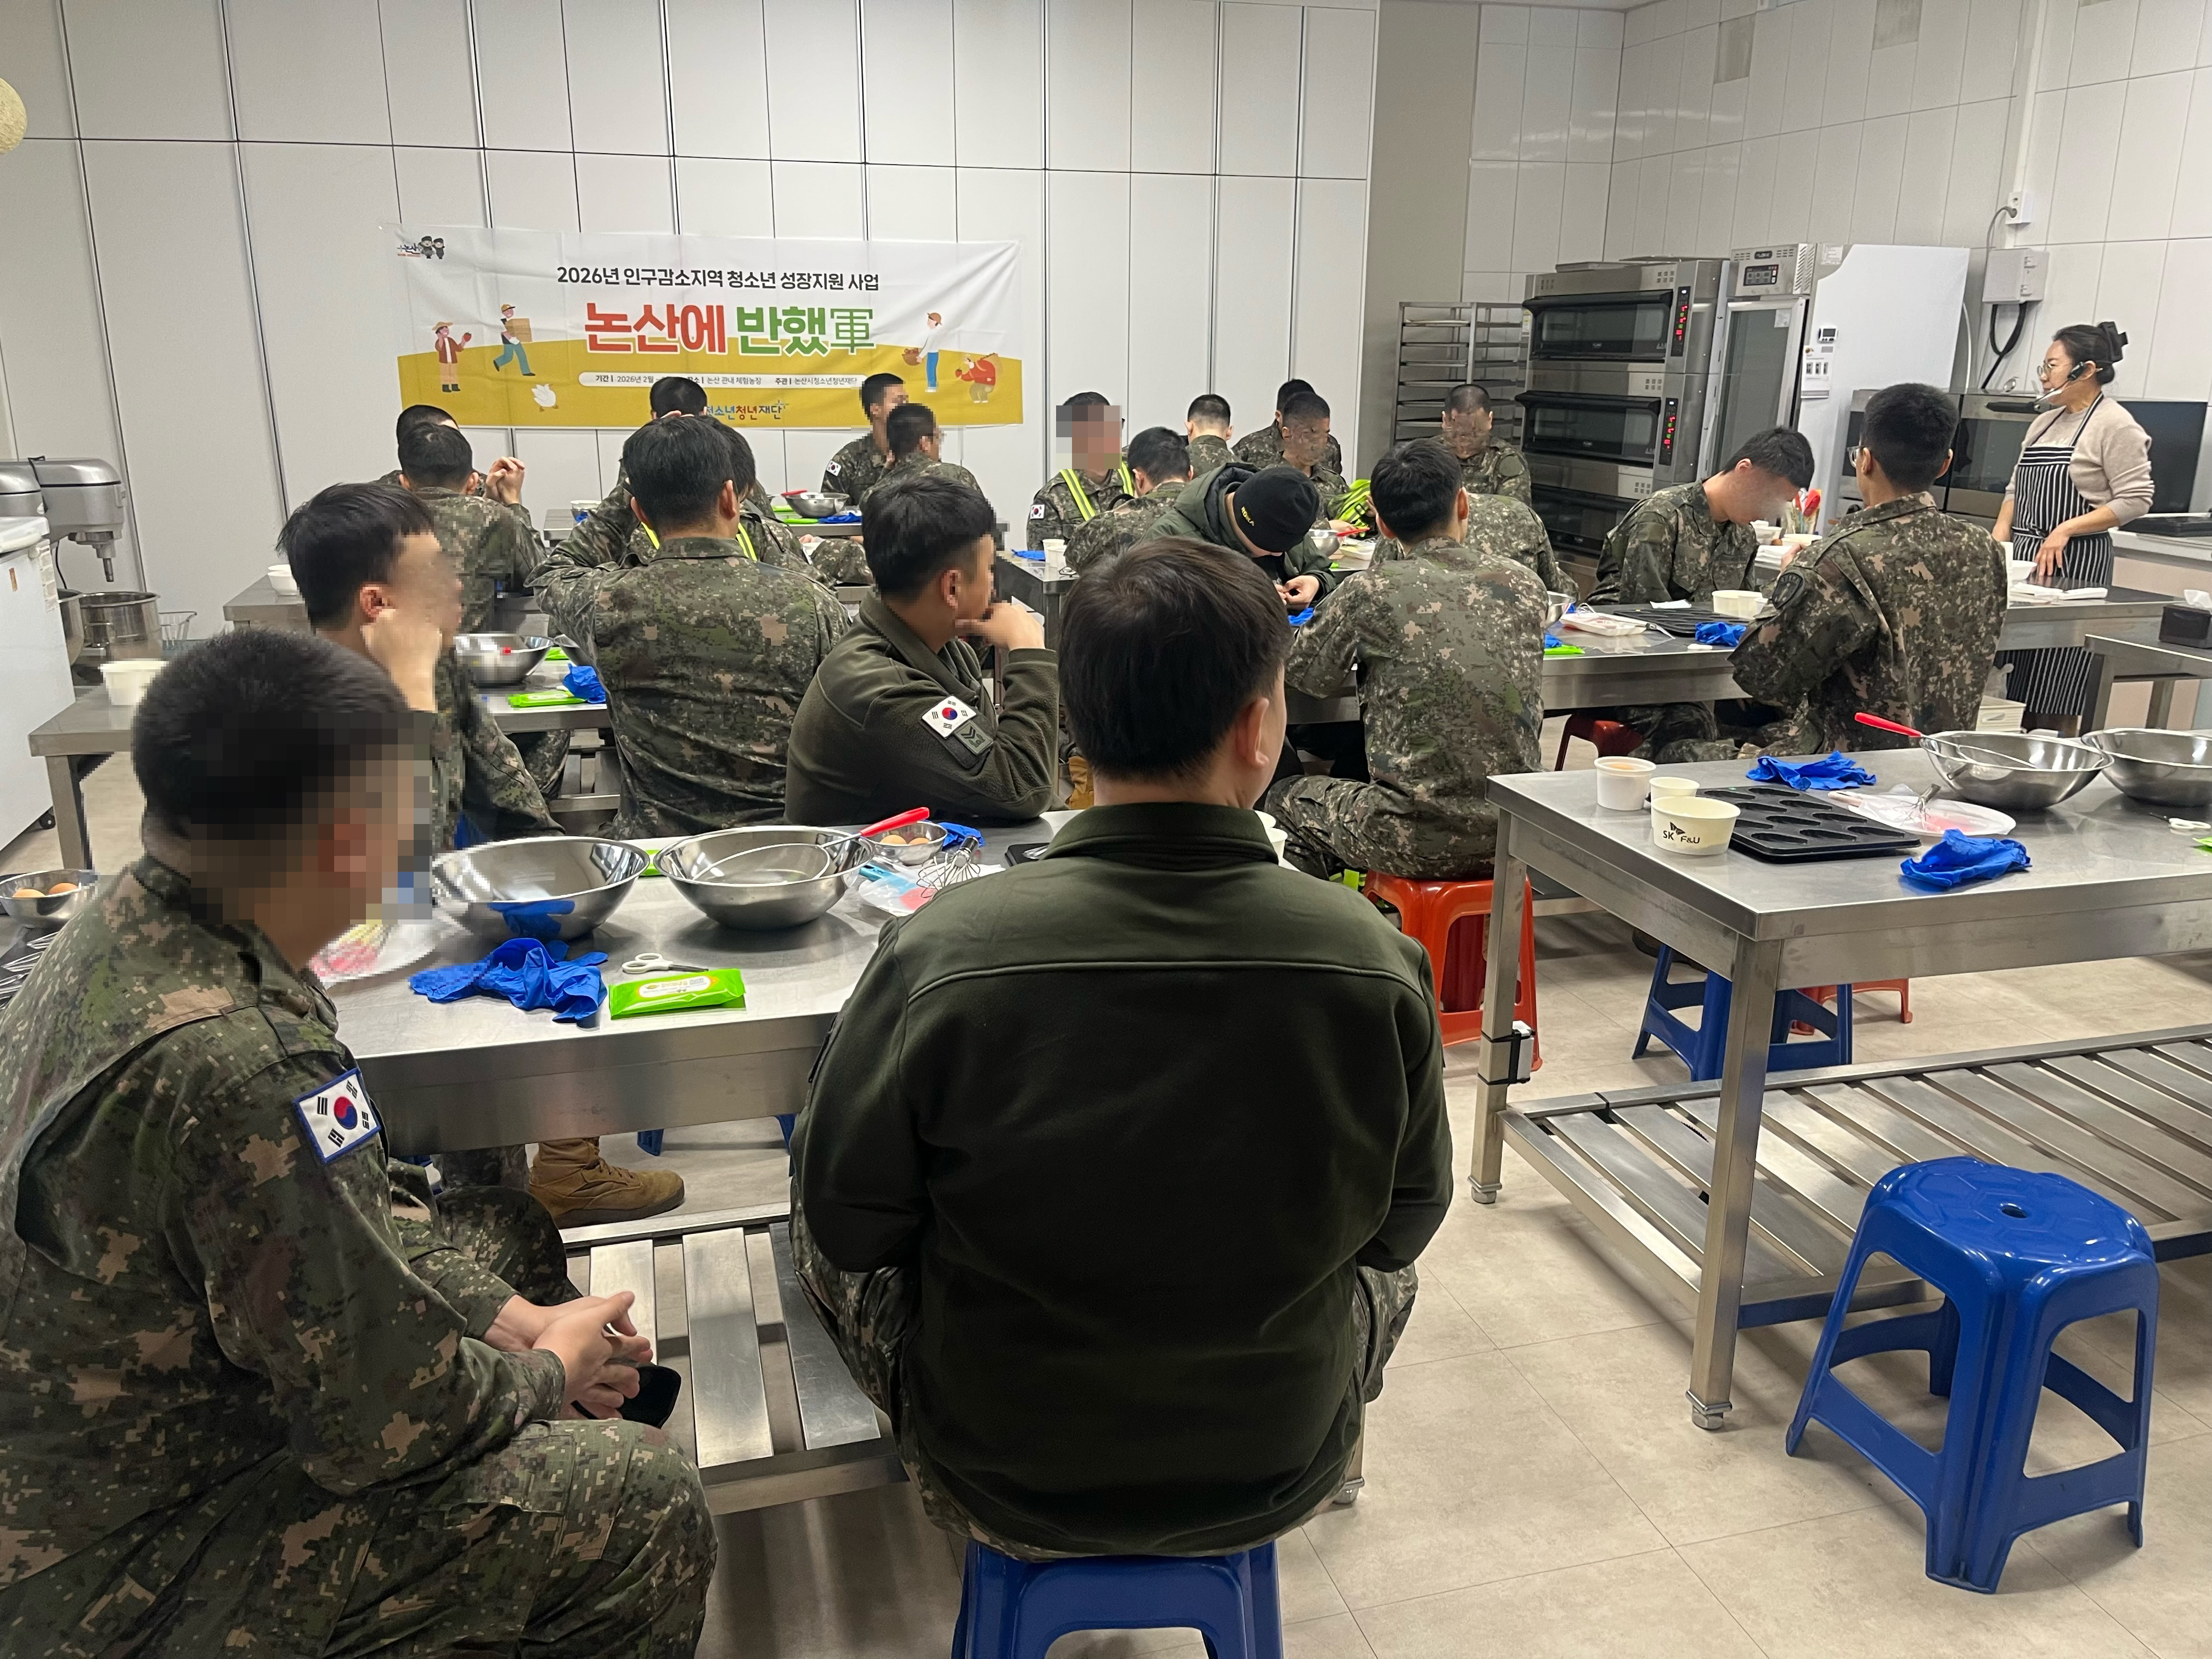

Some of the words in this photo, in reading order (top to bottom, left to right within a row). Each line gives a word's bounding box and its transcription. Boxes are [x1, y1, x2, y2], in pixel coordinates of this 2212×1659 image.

[557, 267, 620, 285] 2026년
[624, 268, 723, 287] 인구감소지역
[727, 270, 776, 289] 청소년
[780, 272, 844, 290] 성장지원
[848, 274, 879, 291] 사업
[585, 303, 726, 353] 논산에
[736, 306, 874, 355] 반했軍
[1241, 506, 1254, 526] ROKA
[1663, 830, 1674, 840] SK
[1680, 836, 1700, 844] F&U
